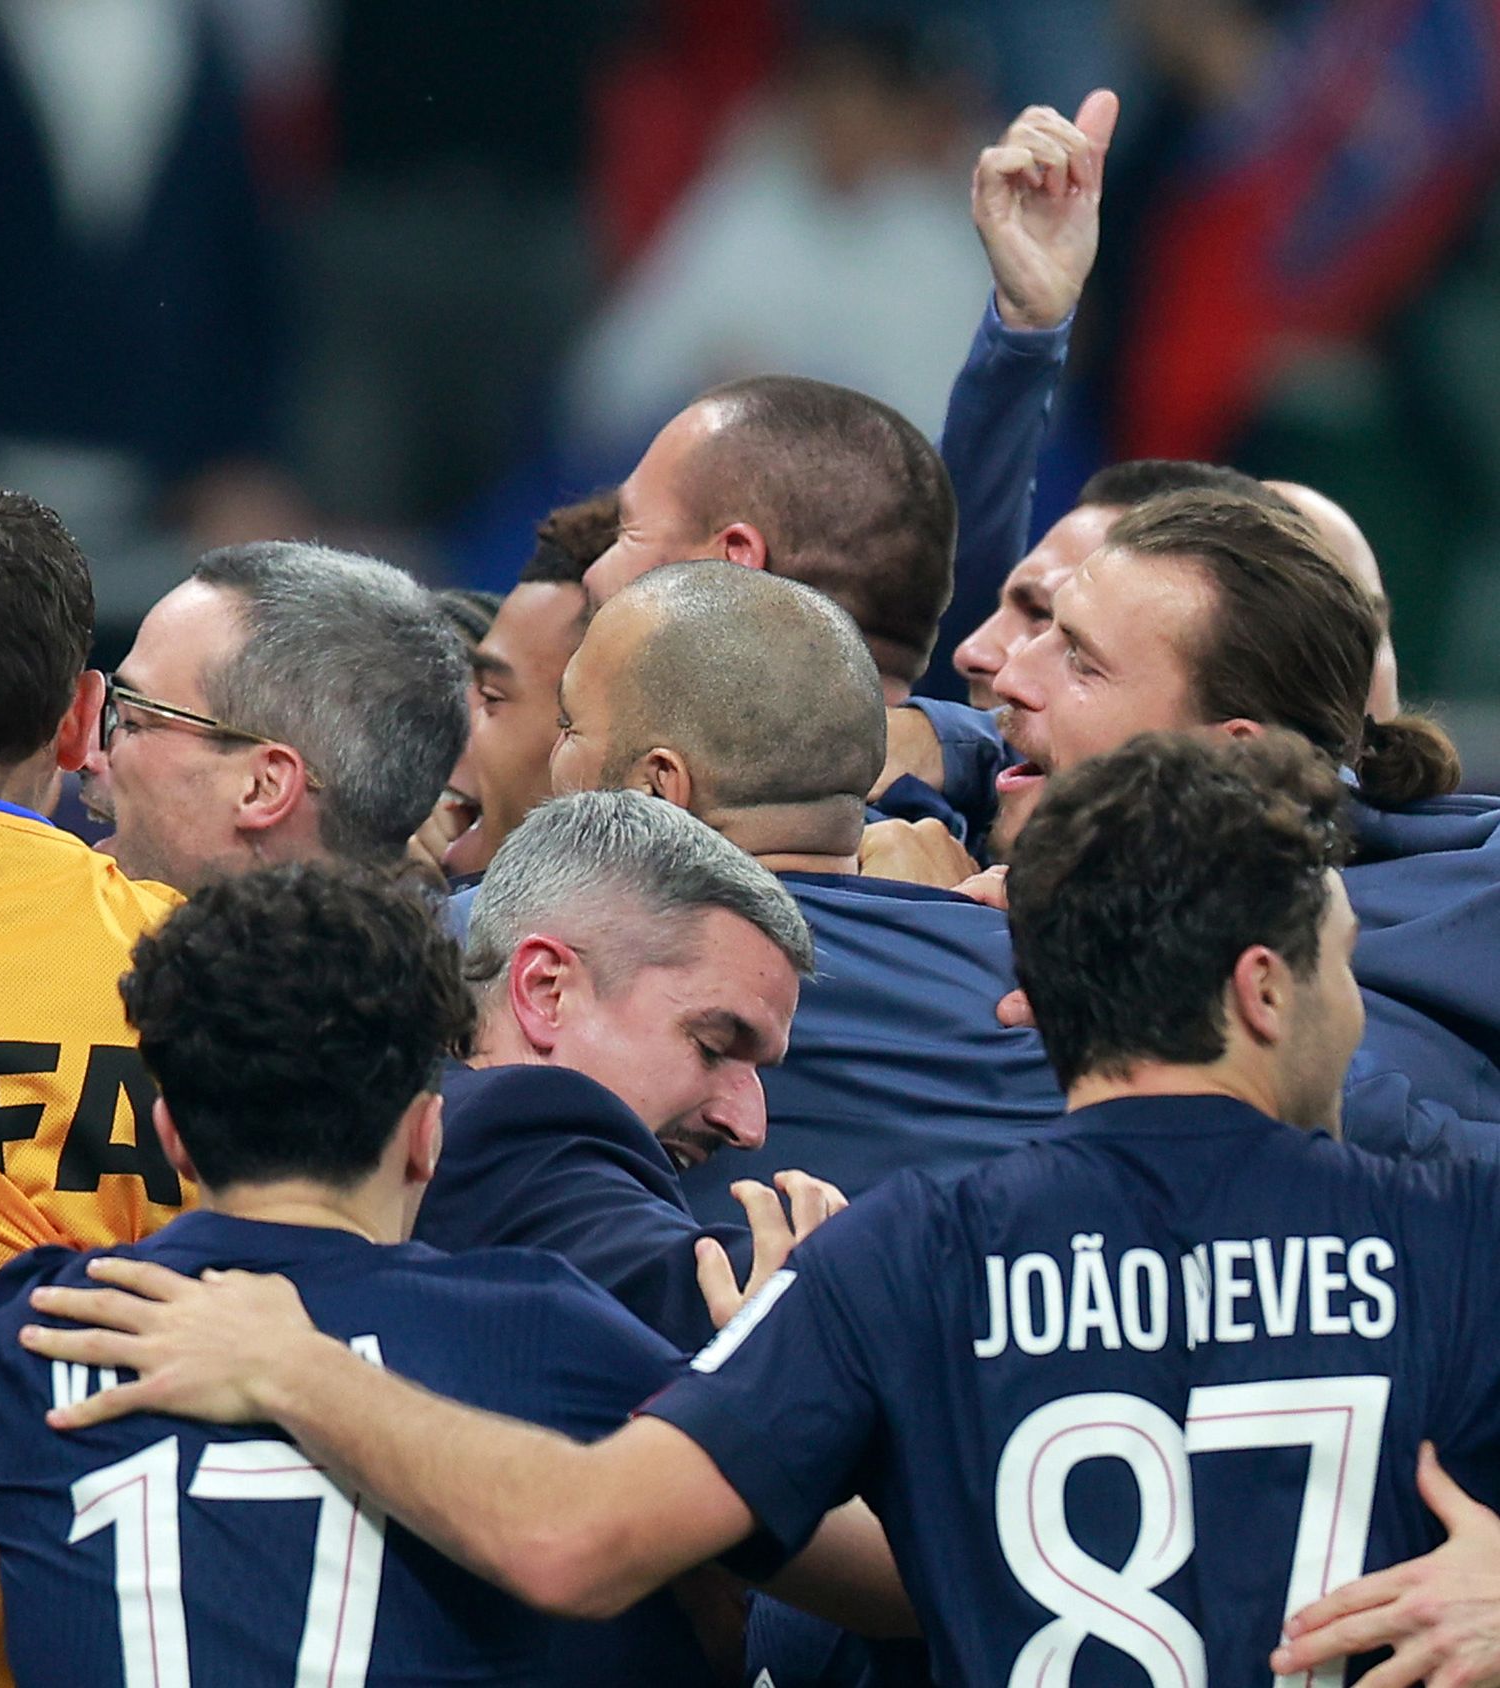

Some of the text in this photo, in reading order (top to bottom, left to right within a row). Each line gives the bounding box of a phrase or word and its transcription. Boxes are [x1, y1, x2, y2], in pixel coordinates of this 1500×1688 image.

[973, 1233, 1397, 1358] JOÃO NEVES
[67, 1434, 388, 1688] 17
[994, 1375, 1391, 1688] 87
